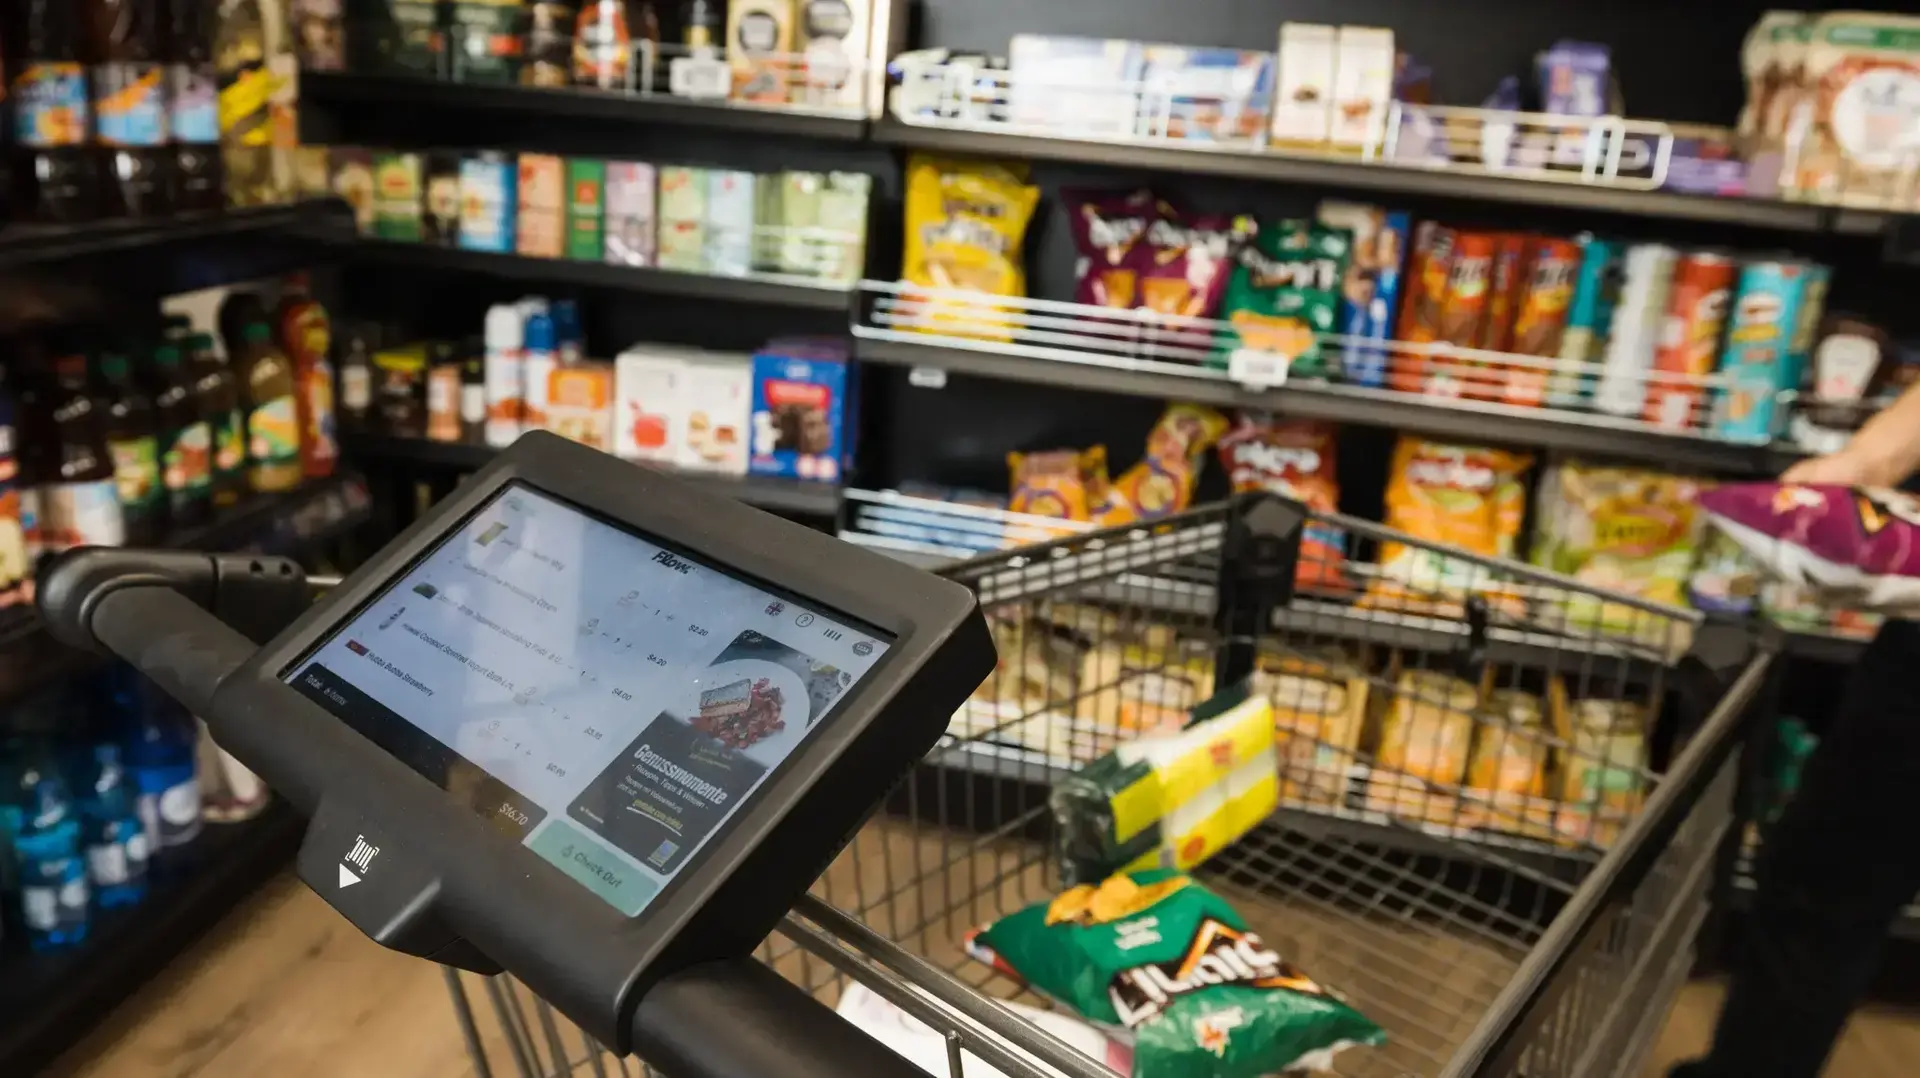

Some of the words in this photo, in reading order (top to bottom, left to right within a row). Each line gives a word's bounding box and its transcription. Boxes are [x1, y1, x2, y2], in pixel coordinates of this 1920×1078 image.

[688, 624, 709, 637] $2.20
[419, 632, 445, 650] Coconut
[442, 645, 469, 664] Scented
[366, 652, 386, 667] Hubba
[383, 662, 404, 678] Bubba
[401, 673, 434, 697] Strawberry
[611, 687, 632, 701] $4.00
[634, 743, 728, 805] Genussmomente
[499, 803, 529, 826] $16.70
[574, 852, 605, 877] Check
[601, 871, 622, 888] Out
